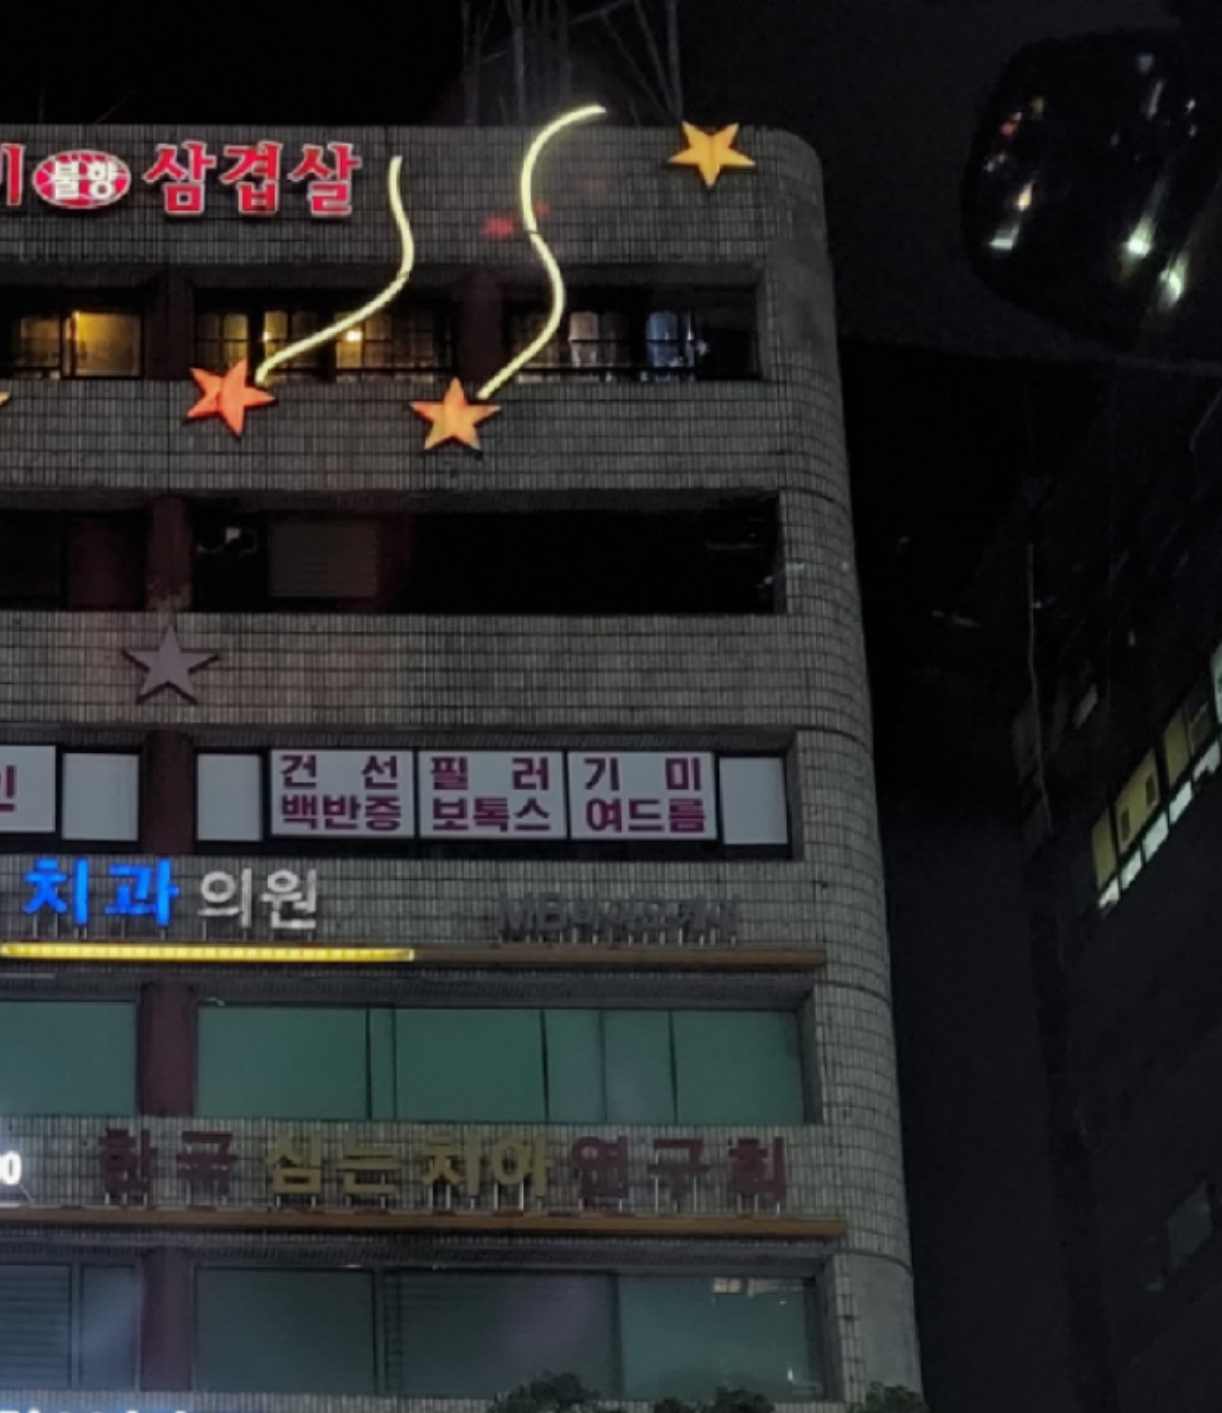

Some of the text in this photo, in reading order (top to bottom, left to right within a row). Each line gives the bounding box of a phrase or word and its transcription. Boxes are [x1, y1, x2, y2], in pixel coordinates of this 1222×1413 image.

[141, 141, 361, 216] 삼겹살
[281, 795, 706, 833] 백반증 보톡스 여드름
[23, 857, 180, 927] 치과
[198, 867, 317, 930] 의원
[97, 1127, 238, 1198] 한국
